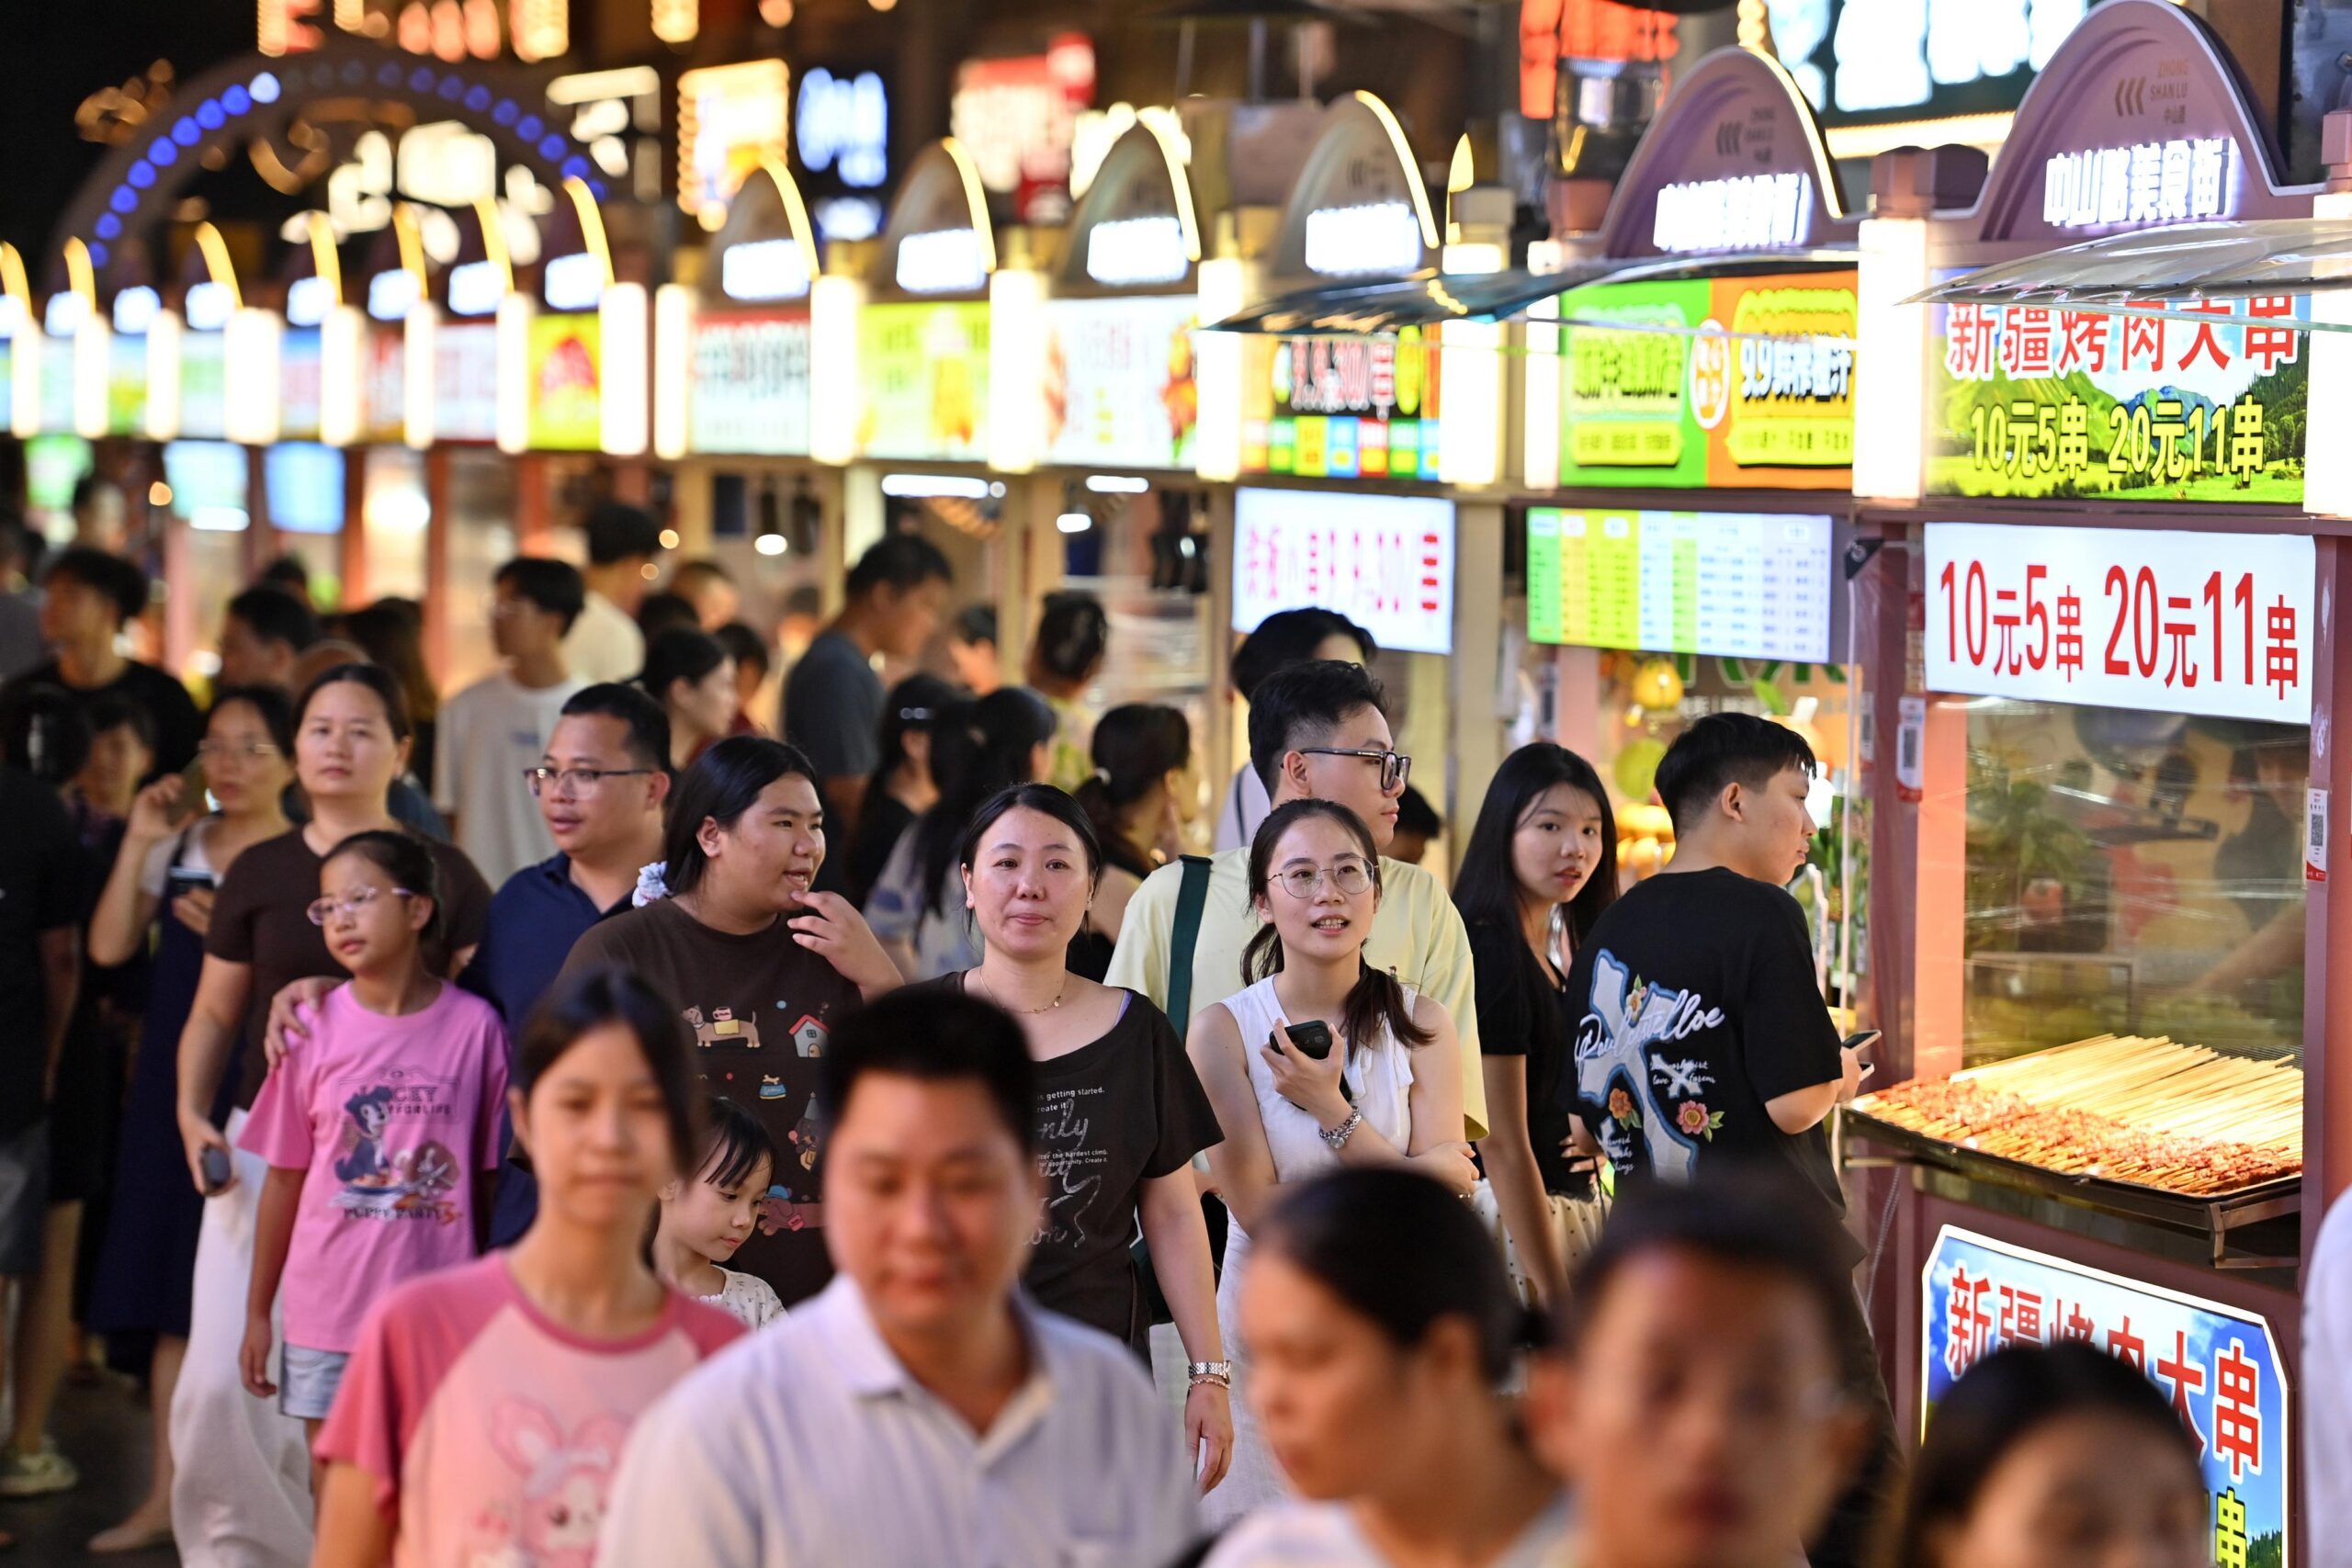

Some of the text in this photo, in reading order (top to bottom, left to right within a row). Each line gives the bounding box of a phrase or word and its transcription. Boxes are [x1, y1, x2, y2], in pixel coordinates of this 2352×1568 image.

[1950, 296, 2294, 373] 新疆烤肉大串
[1970, 392, 2265, 483] 10元5串 20元11串
[1940, 560, 2083, 682] 10元5串
[2104, 565, 2298, 700] 20元11串
[1036, 1104, 1058, 1113] reate
[1046, 1089, 1076, 1101] getting
[1077, 1086, 1105, 1096] started.
